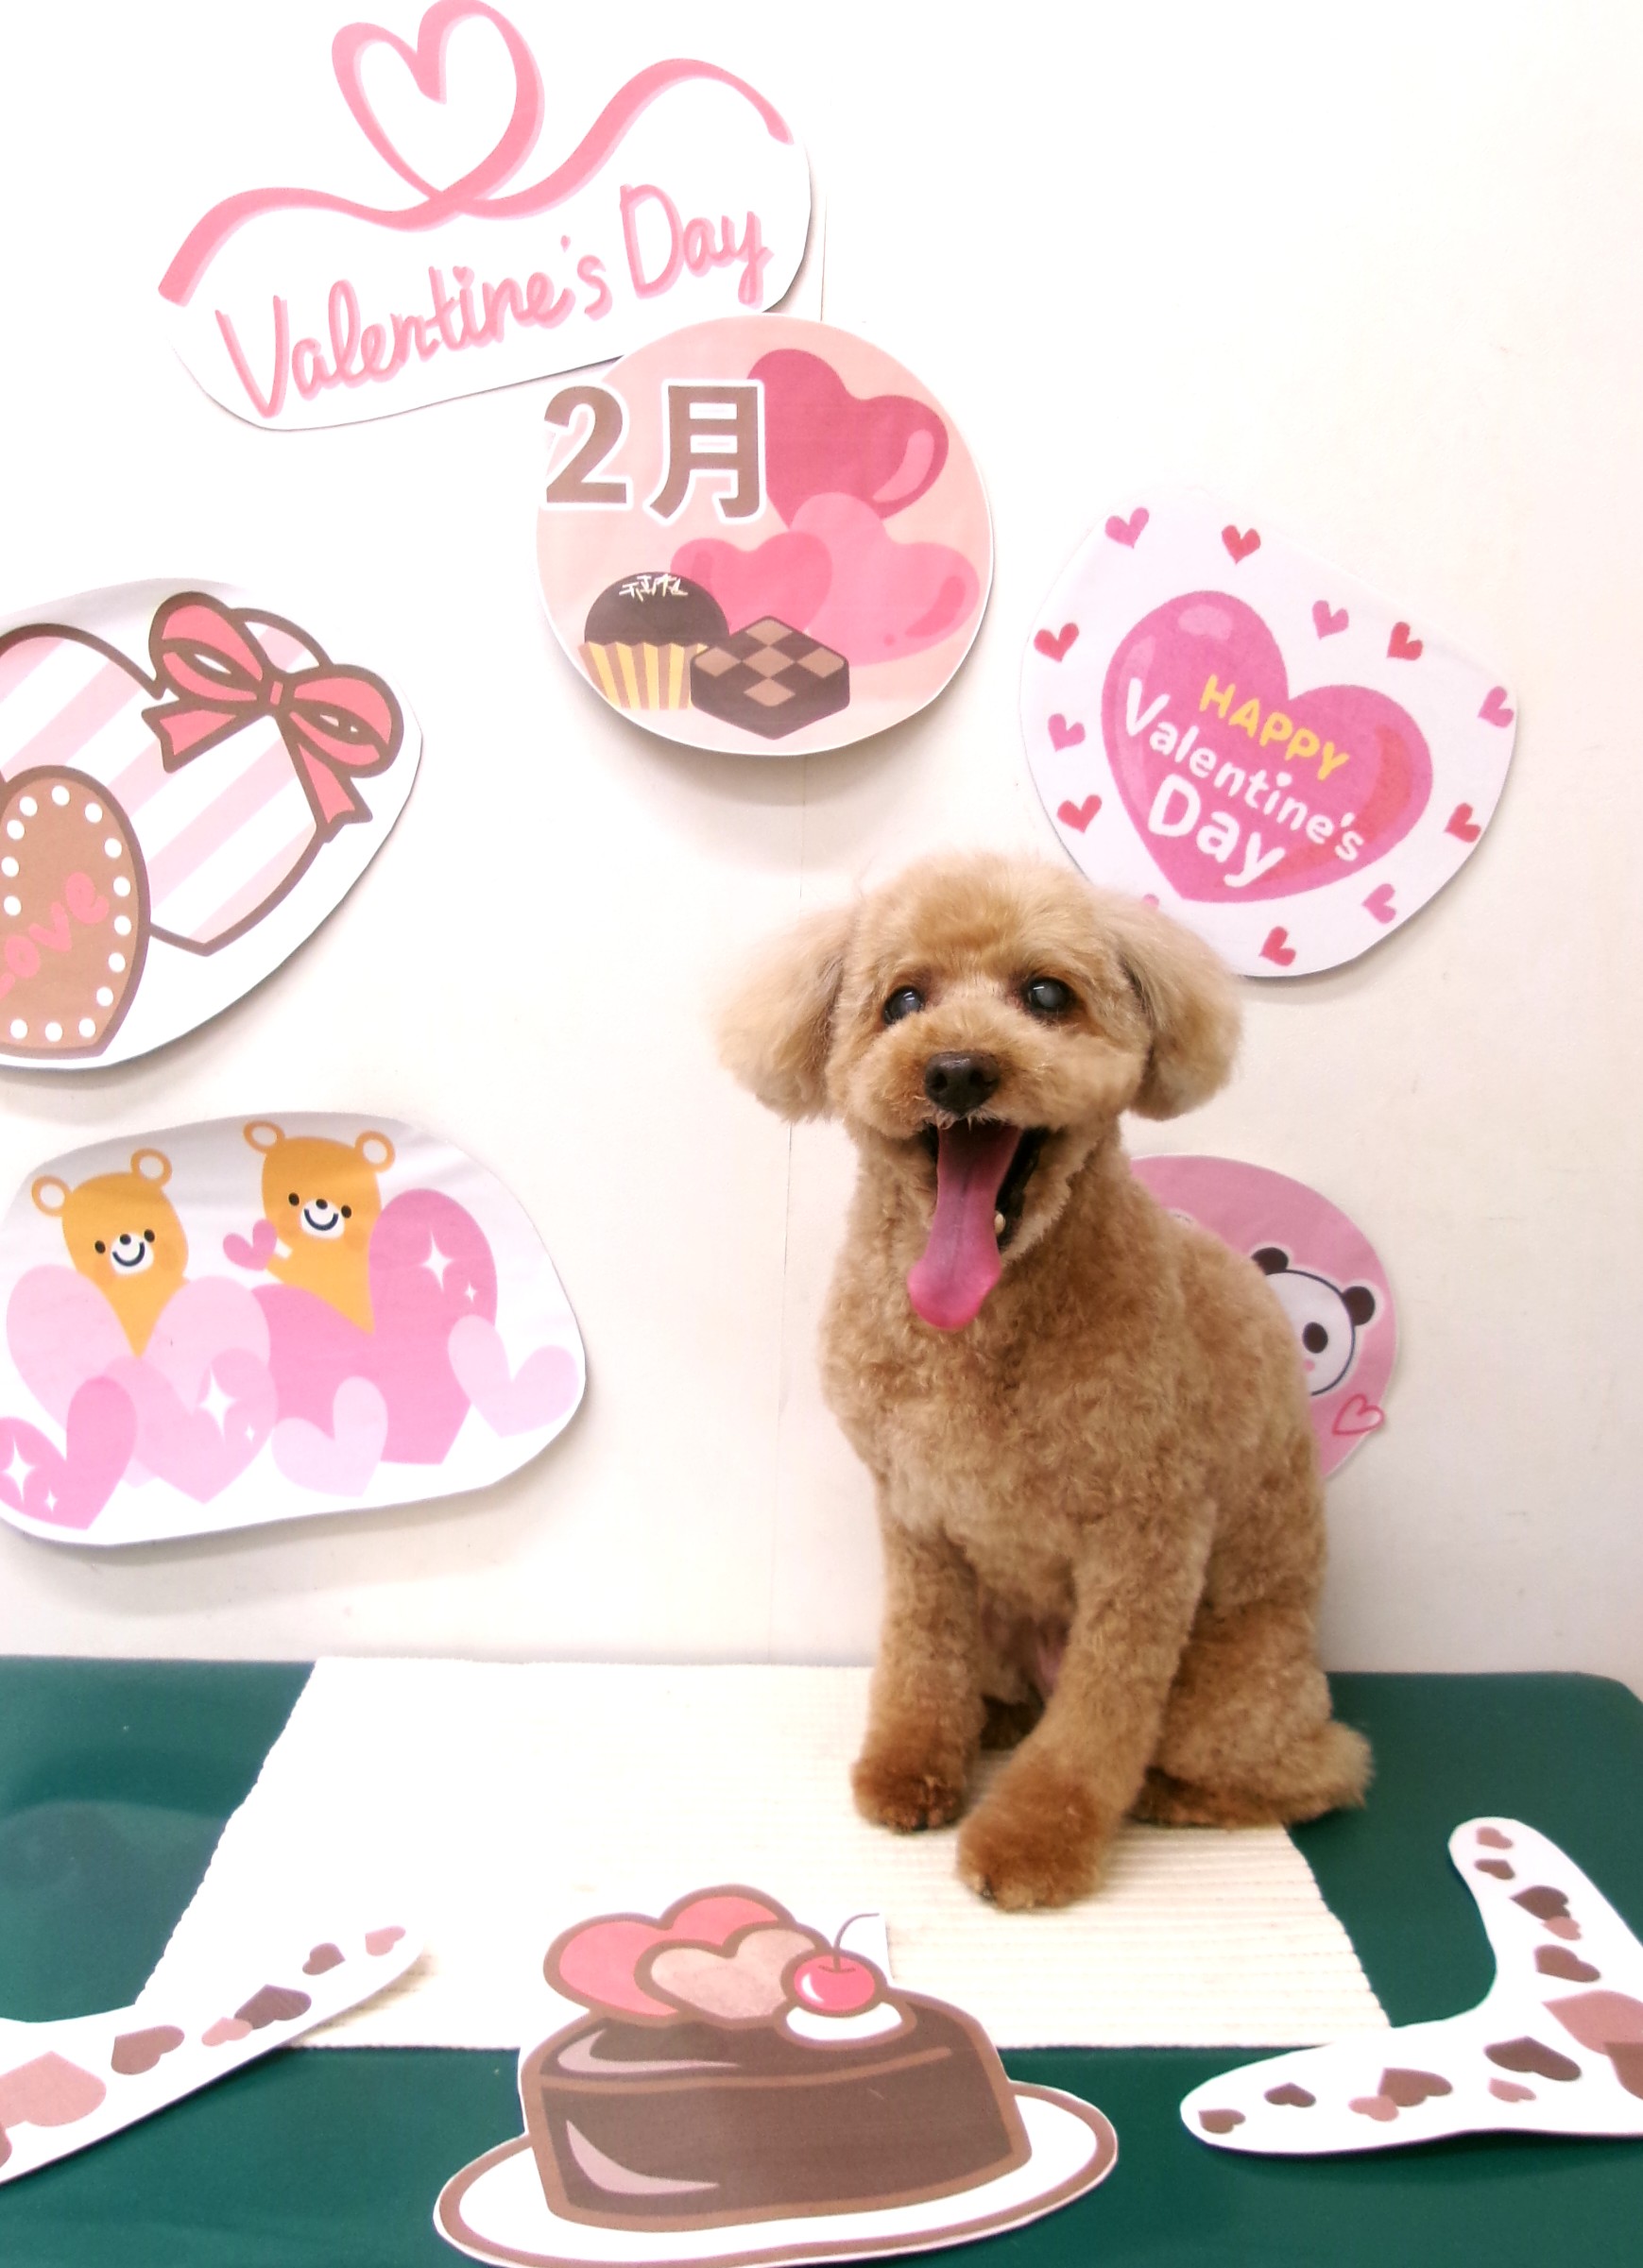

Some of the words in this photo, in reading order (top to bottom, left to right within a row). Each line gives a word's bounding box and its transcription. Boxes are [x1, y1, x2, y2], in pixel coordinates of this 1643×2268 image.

[215, 234, 613, 418] Valentine's
[619, 183, 775, 309] Day
[542, 381, 766, 524] 2月
[1126, 677, 1364, 861] Valentine's
[1199, 674, 1349, 781] HAPPY
[1147, 774, 1286, 887] Day
